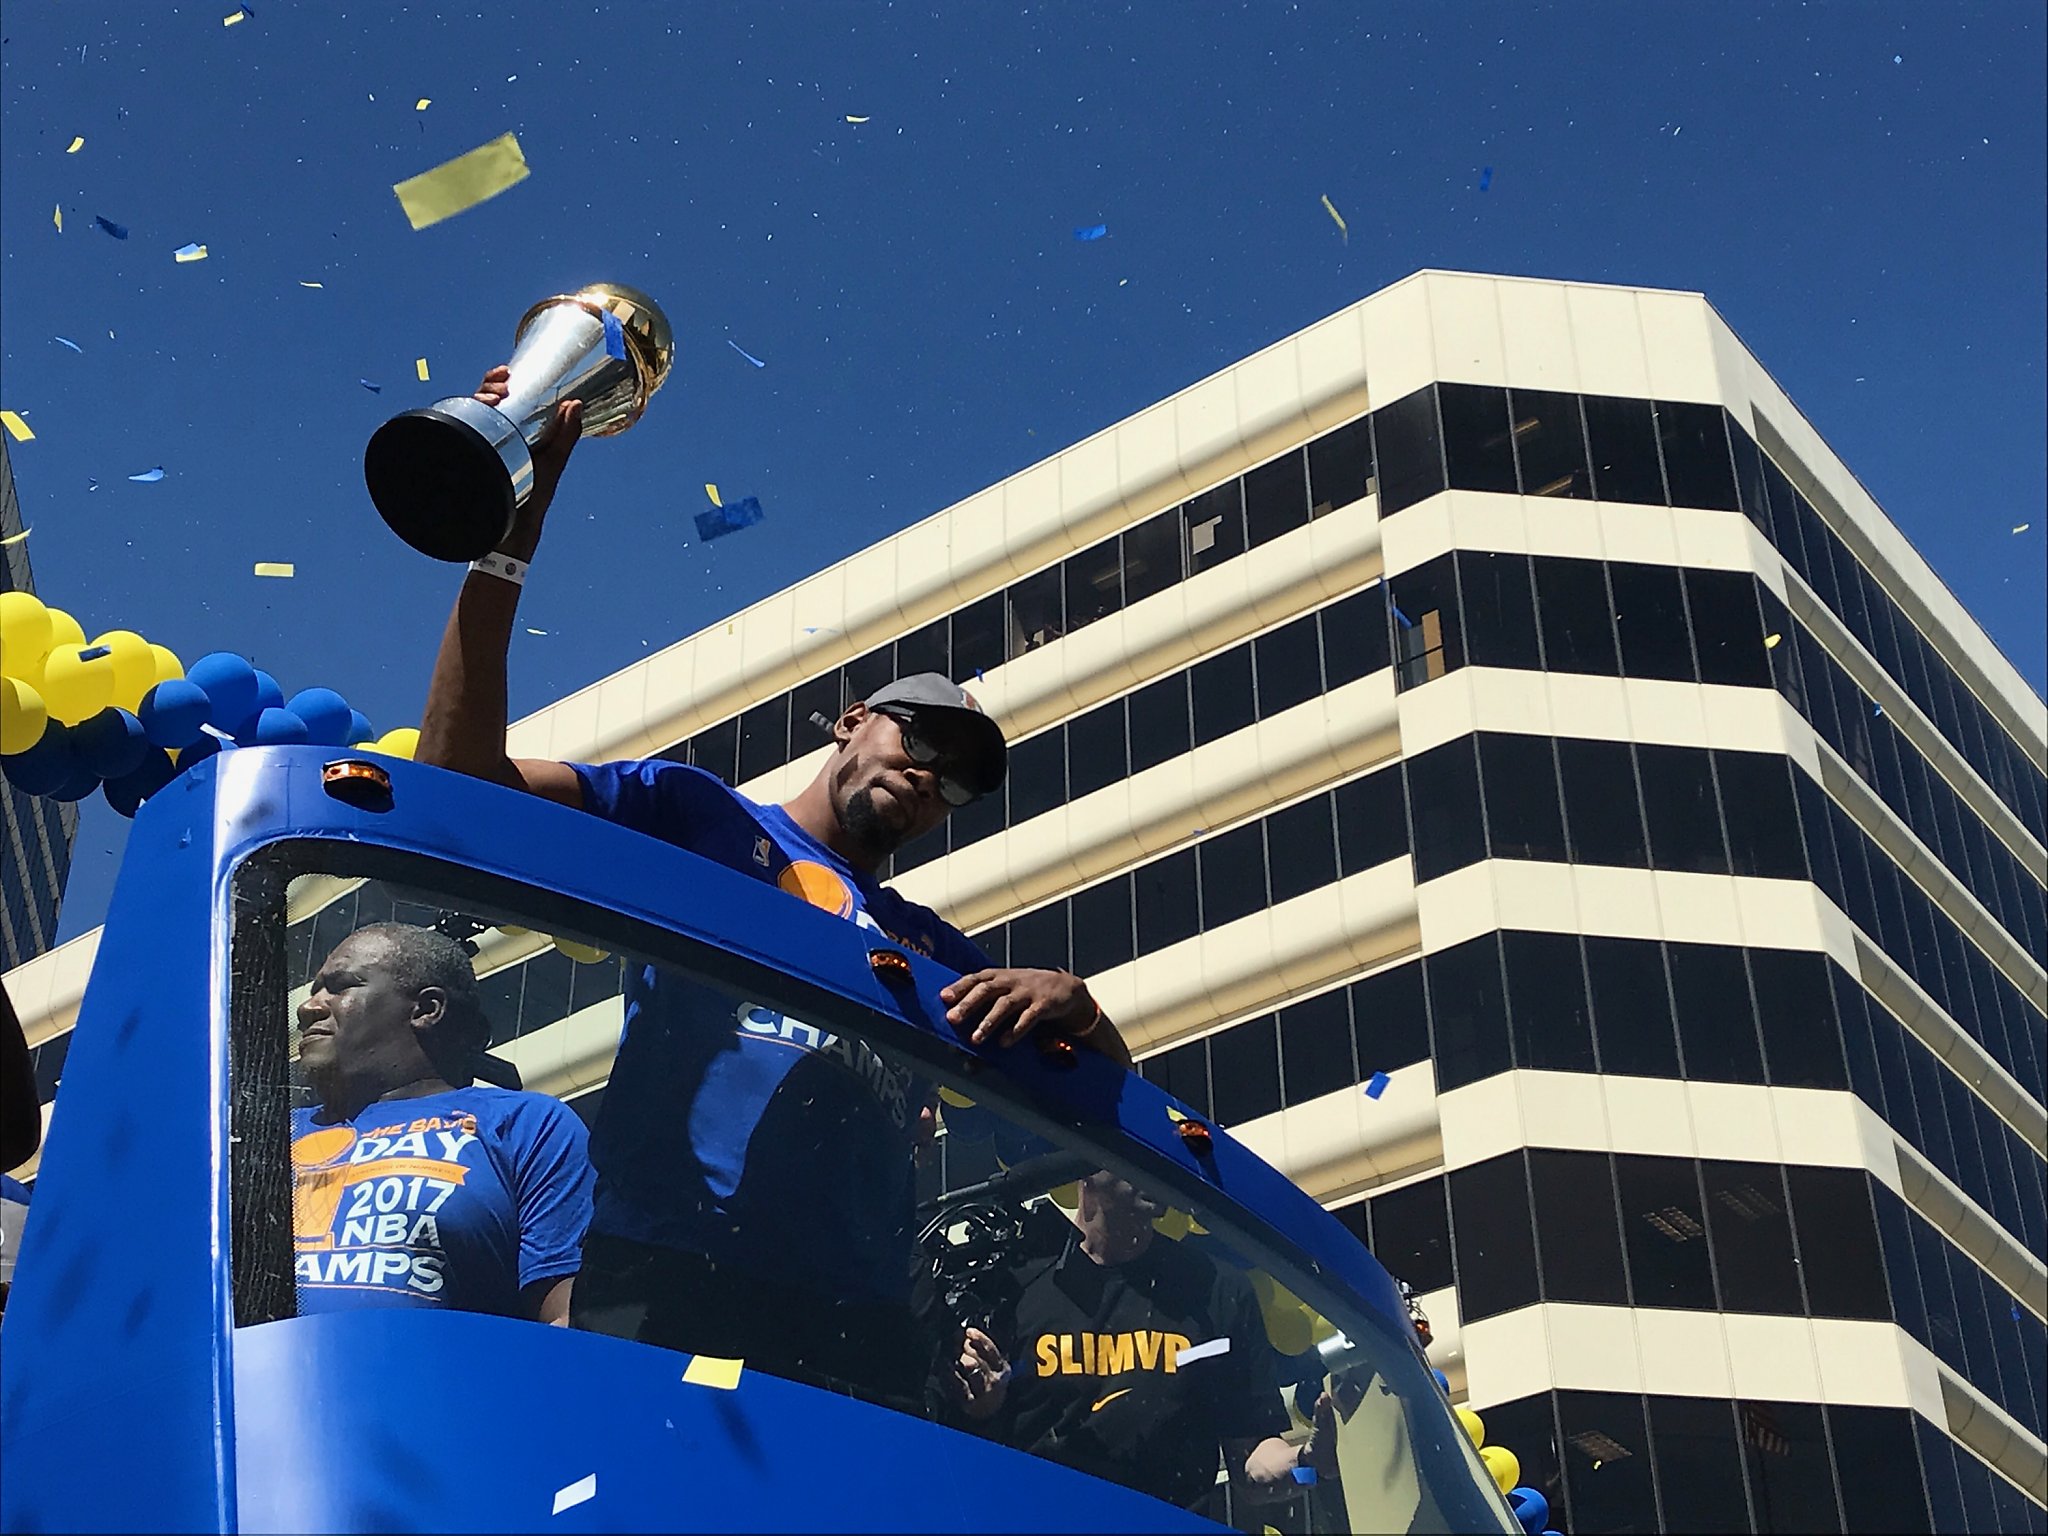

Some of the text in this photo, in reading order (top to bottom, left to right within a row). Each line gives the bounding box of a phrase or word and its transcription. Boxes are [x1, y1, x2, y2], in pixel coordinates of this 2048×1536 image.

[350, 1130, 479, 1165] DAY
[346, 1177, 457, 1219] 2017
[340, 1213, 441, 1248] NBA
[295, 1252, 446, 1292] AMPS
[1036, 1330, 1192, 1377] SLIMVP
